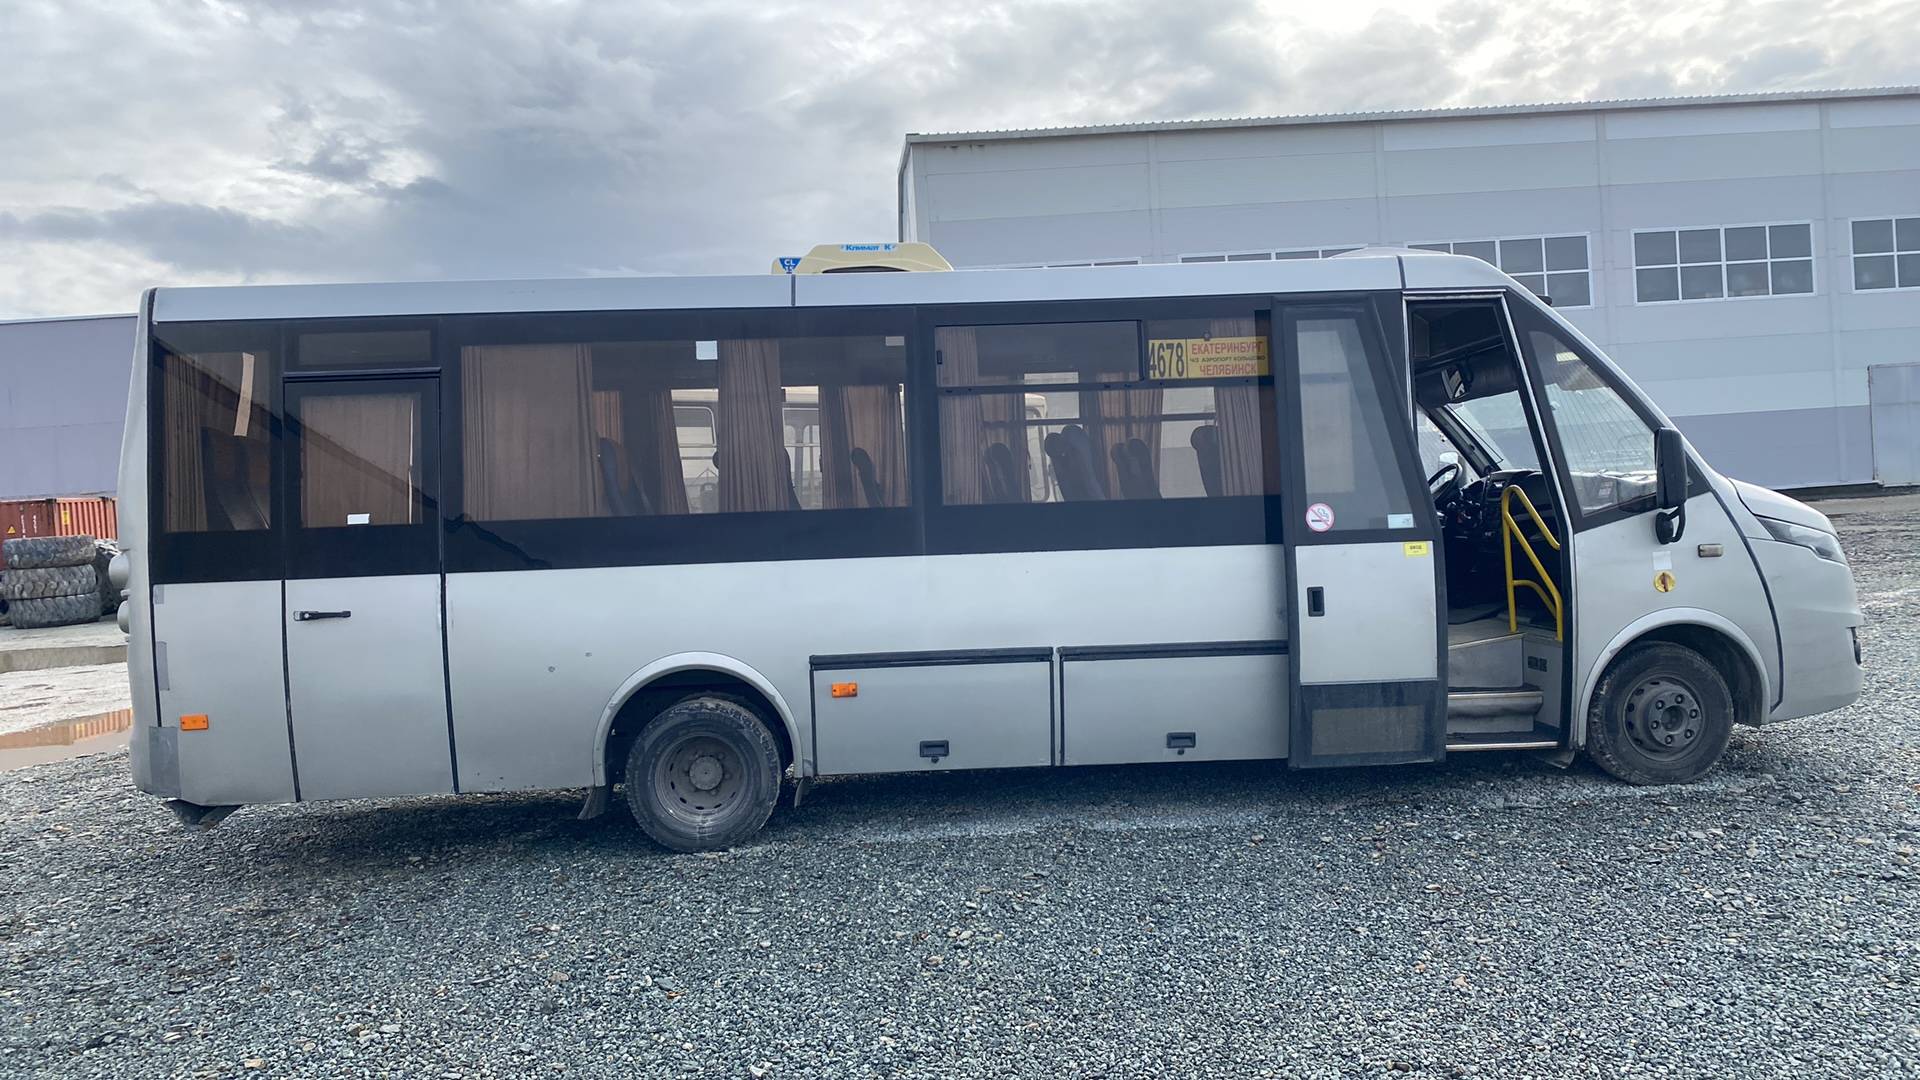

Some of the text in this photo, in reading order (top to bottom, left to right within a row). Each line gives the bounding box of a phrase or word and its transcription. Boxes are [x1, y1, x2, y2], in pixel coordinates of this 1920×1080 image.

[1191, 342, 1263, 355] ЕКАТЕРИНБУРГ
[1149, 342, 1185, 378] 4678
[1200, 363, 1257, 376] ЧЕЛЯБИНСК
